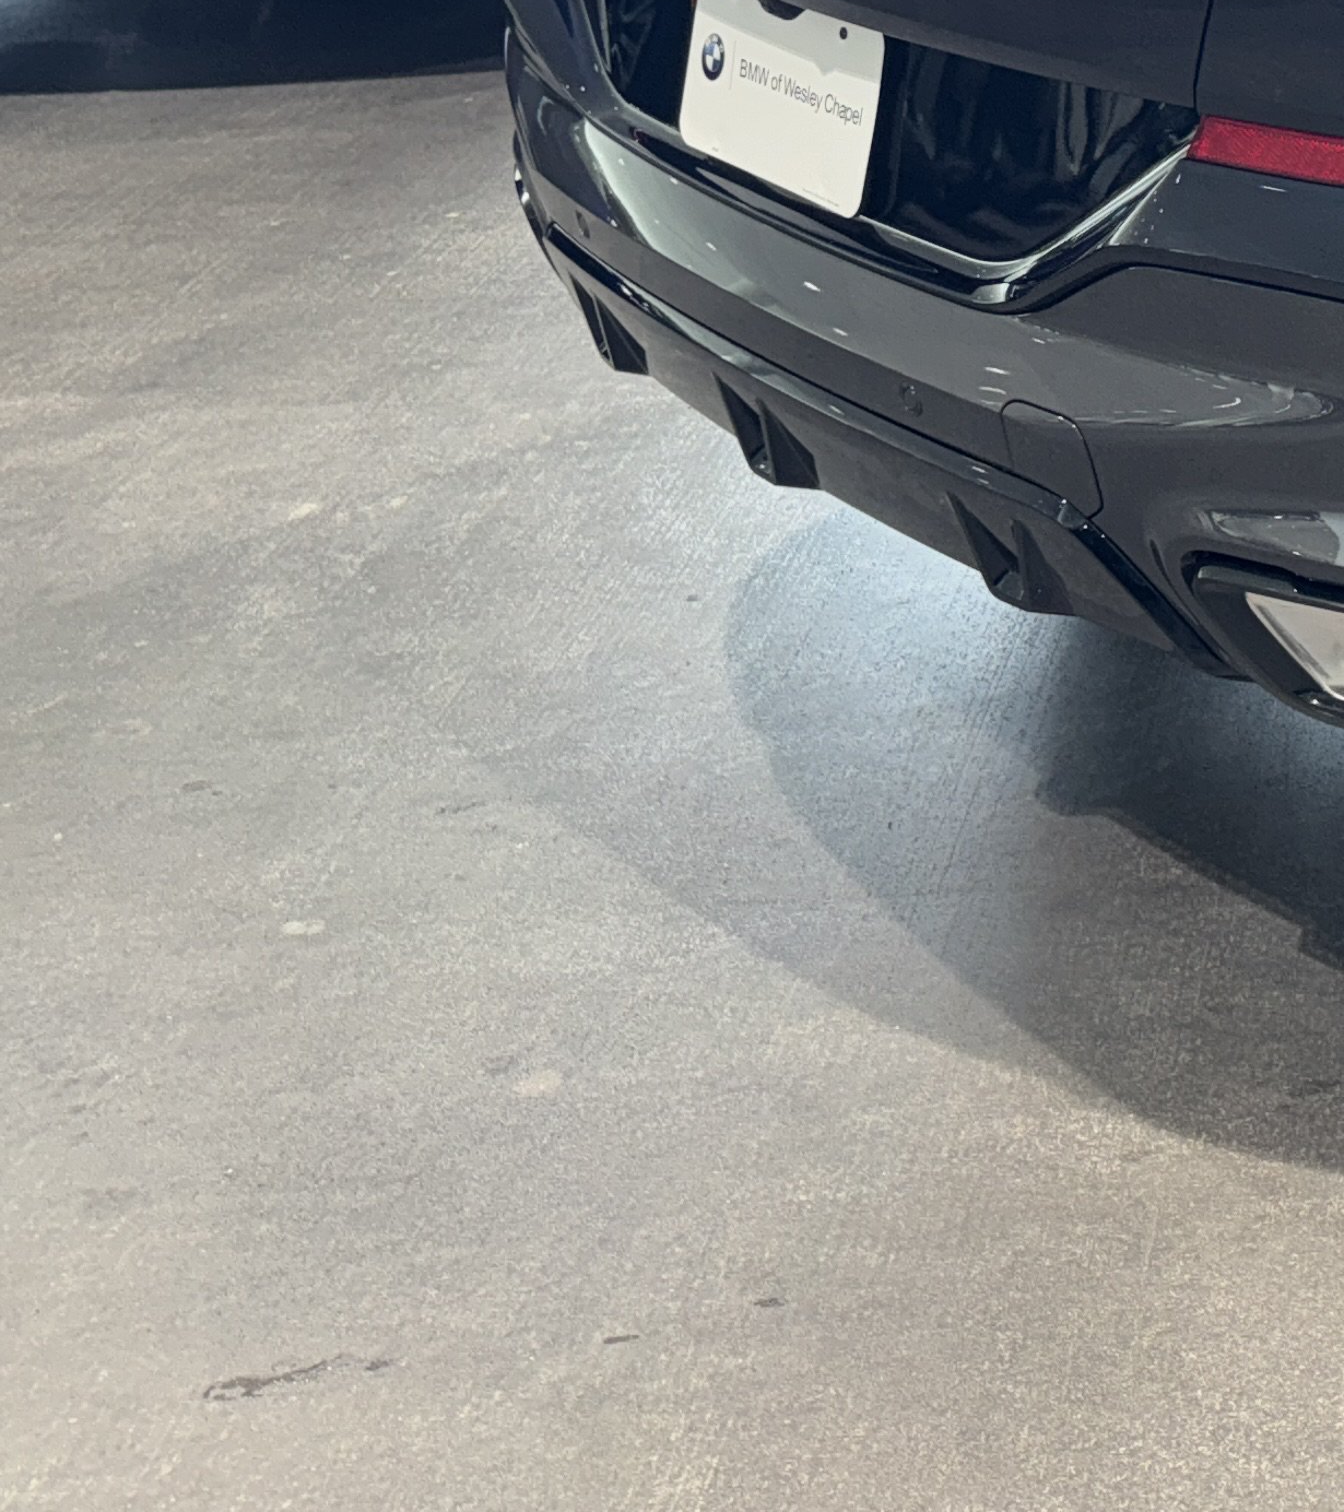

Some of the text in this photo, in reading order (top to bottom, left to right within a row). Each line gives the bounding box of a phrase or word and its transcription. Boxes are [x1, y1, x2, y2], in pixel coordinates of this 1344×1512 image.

[739, 57, 863, 128] BMW of Wesley Chapel
